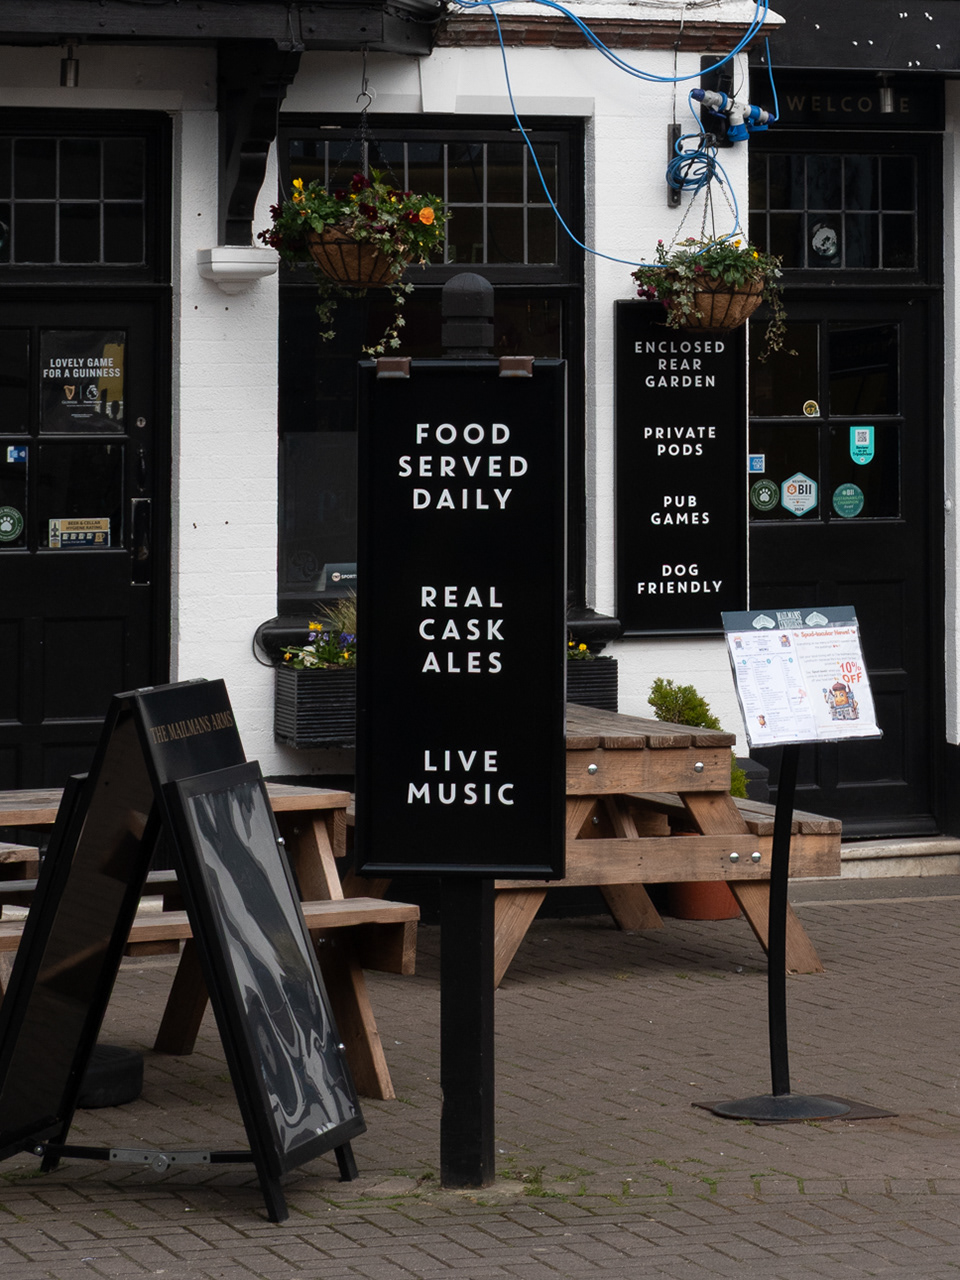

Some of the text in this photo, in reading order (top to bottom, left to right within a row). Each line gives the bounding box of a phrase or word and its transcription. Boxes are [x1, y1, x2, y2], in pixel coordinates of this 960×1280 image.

[787, 96, 910, 113] WELCOE
[635, 342, 724, 353] ENCLOSED
[50, 358, 114, 367] LOVELY GAME
[659, 359, 701, 370] REAR
[43, 368, 121, 378] FOR A GUINNESS
[646, 376, 714, 387] GARDEN
[417, 424, 509, 444] FOOD
[645, 427, 715, 438] PRIVATE
[658, 444, 702, 455] PODS
[399, 456, 527, 477] SERVED
[798, 484, 812, 495] BII
[413, 489, 512, 509] DAILY
[664, 496, 696, 507] PUB
[651, 512, 709, 524] GAMES
[663, 564, 698, 576] DOG
[638, 581, 722, 594] FRIENDLY
[422, 586, 502, 607] REAL
[419, 619, 504, 640] CASK
[422, 652, 501, 673] ALES
[840, 661, 861, 673] 10%
[842, 672, 862, 683] OFF
[150, 710, 234, 744] THE MAILMANS ARMS
[425, 750, 497, 771] LIVE
[408, 783, 513, 805] MUSIC
